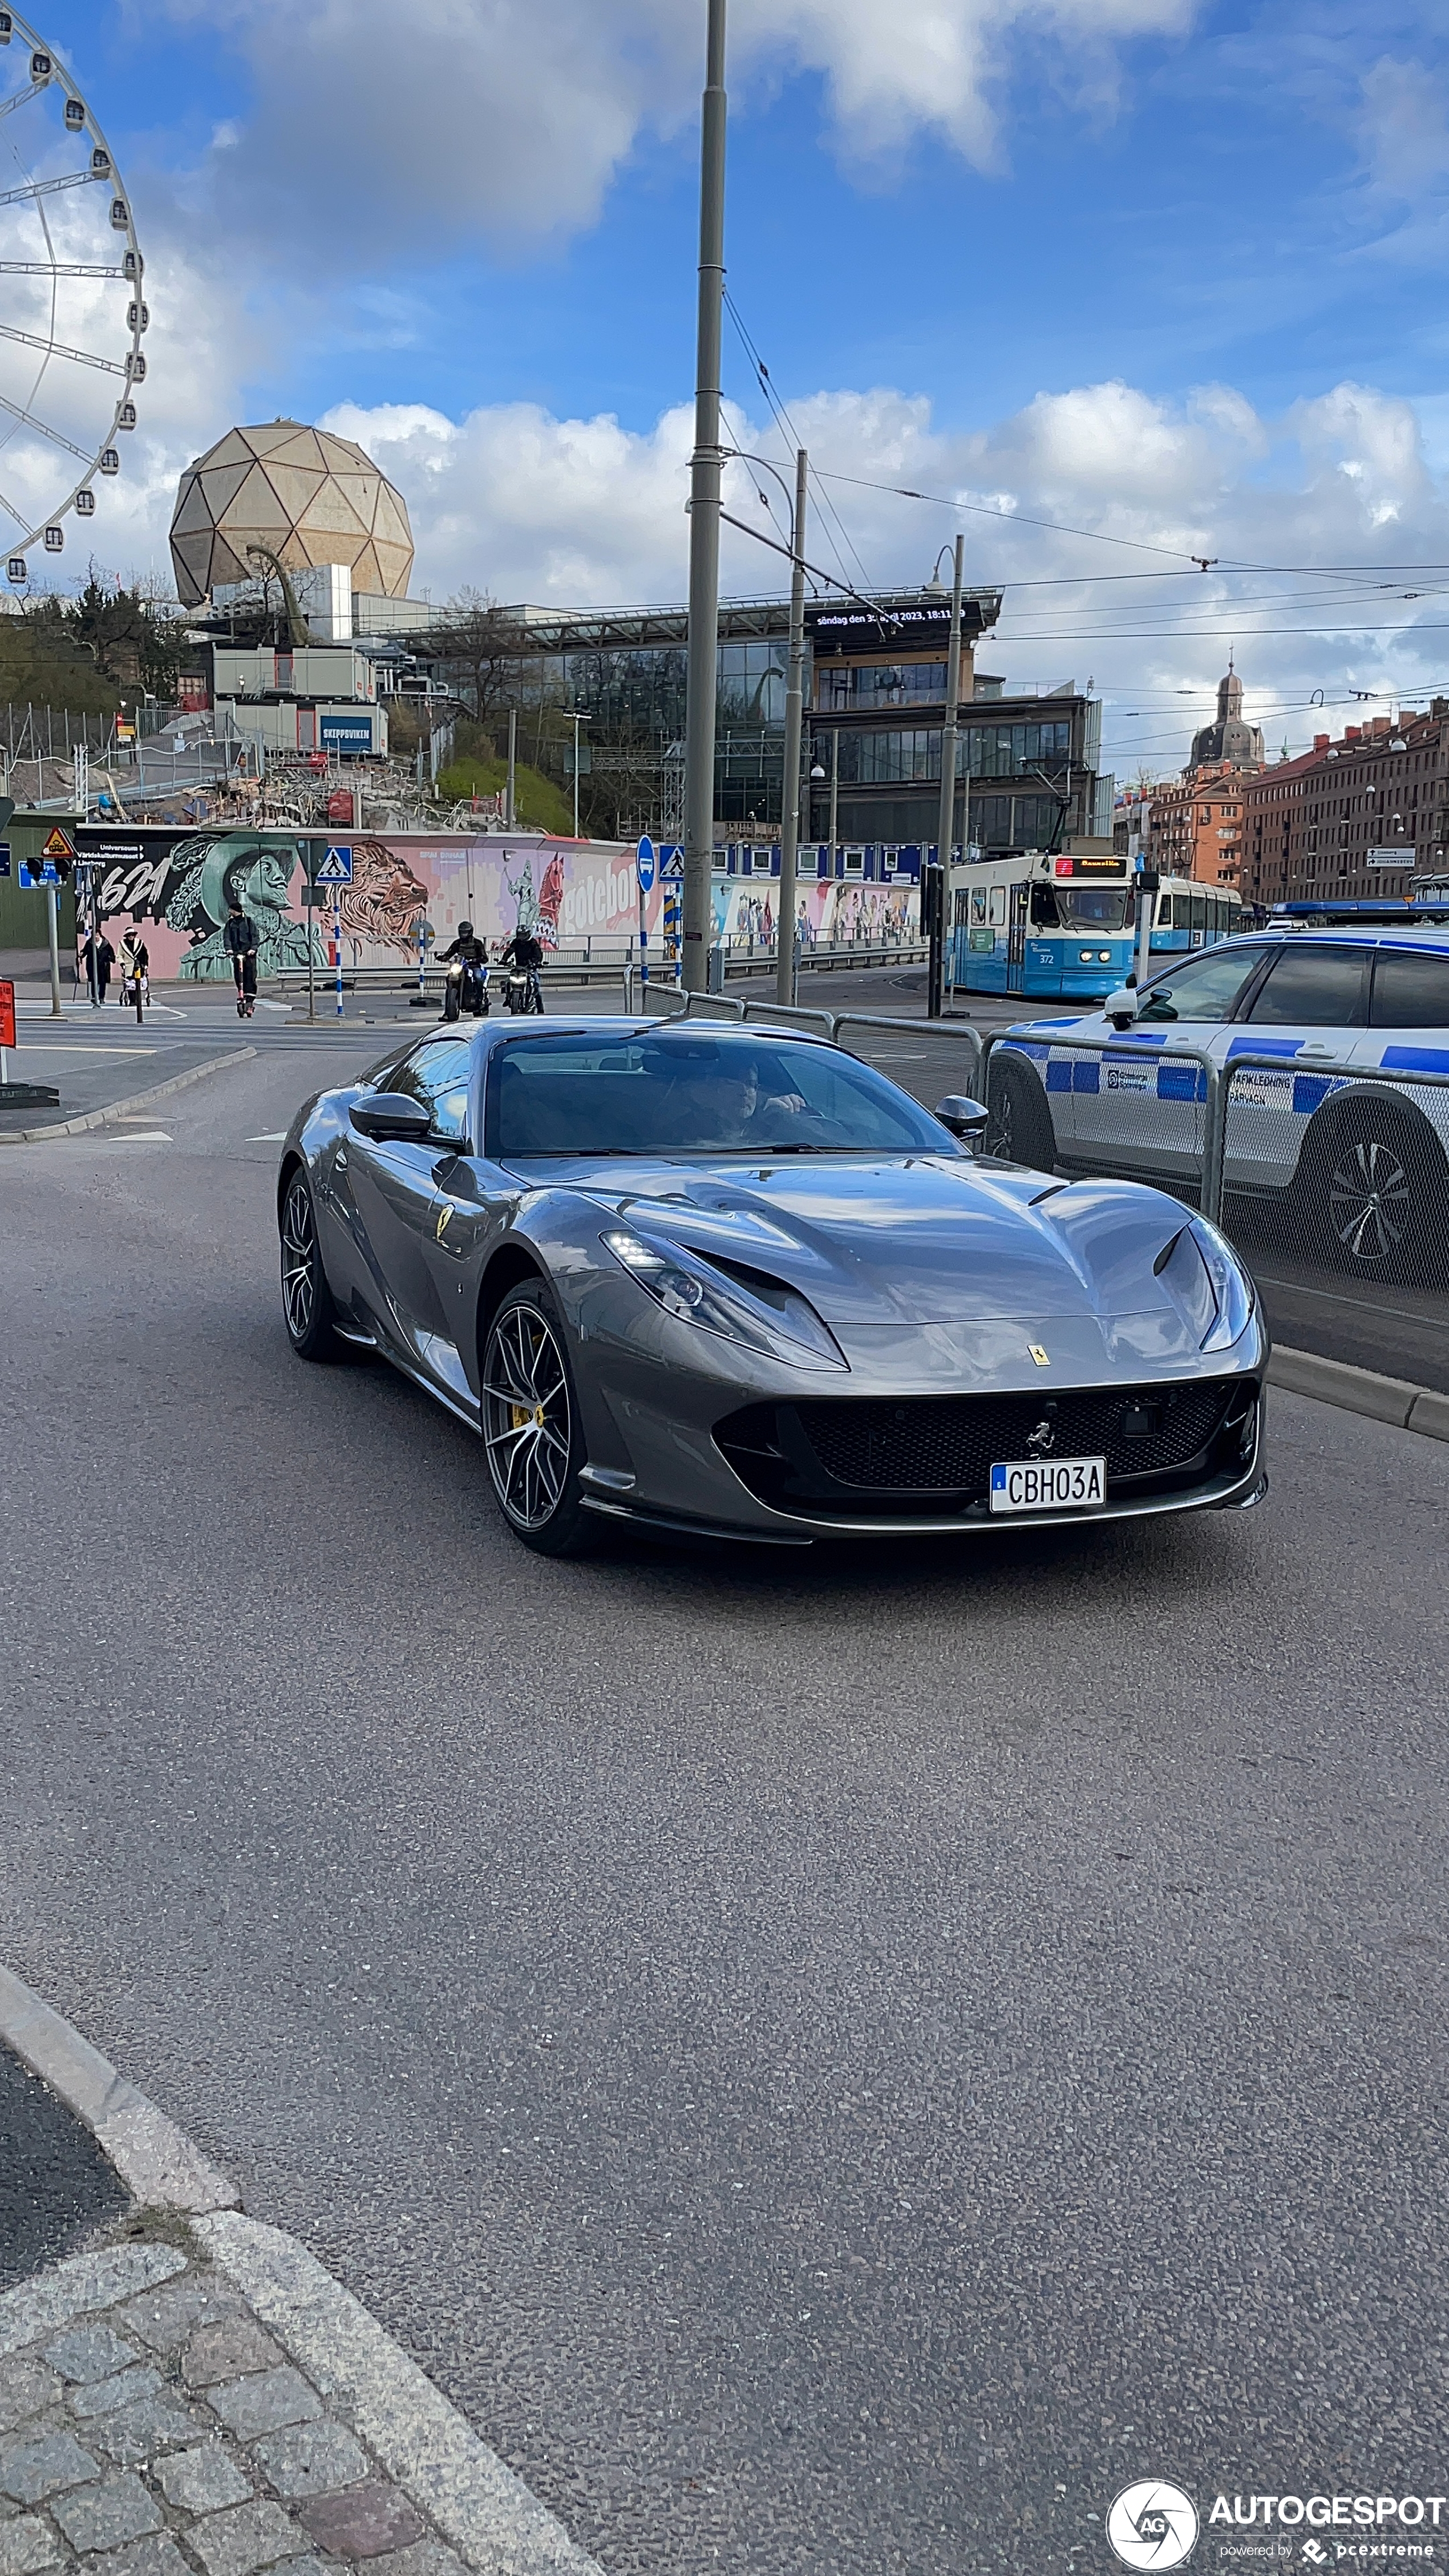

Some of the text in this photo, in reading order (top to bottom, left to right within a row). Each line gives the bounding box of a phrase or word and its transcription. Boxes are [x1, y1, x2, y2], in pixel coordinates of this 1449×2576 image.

[817, 616, 848, 625] söndag
[900, 611, 925, 621] 2023,
[323, 728, 369, 739] SKEPPSVIKEN
[565, 862, 650, 942] götebor
[1040, 954, 1054, 964] 372
